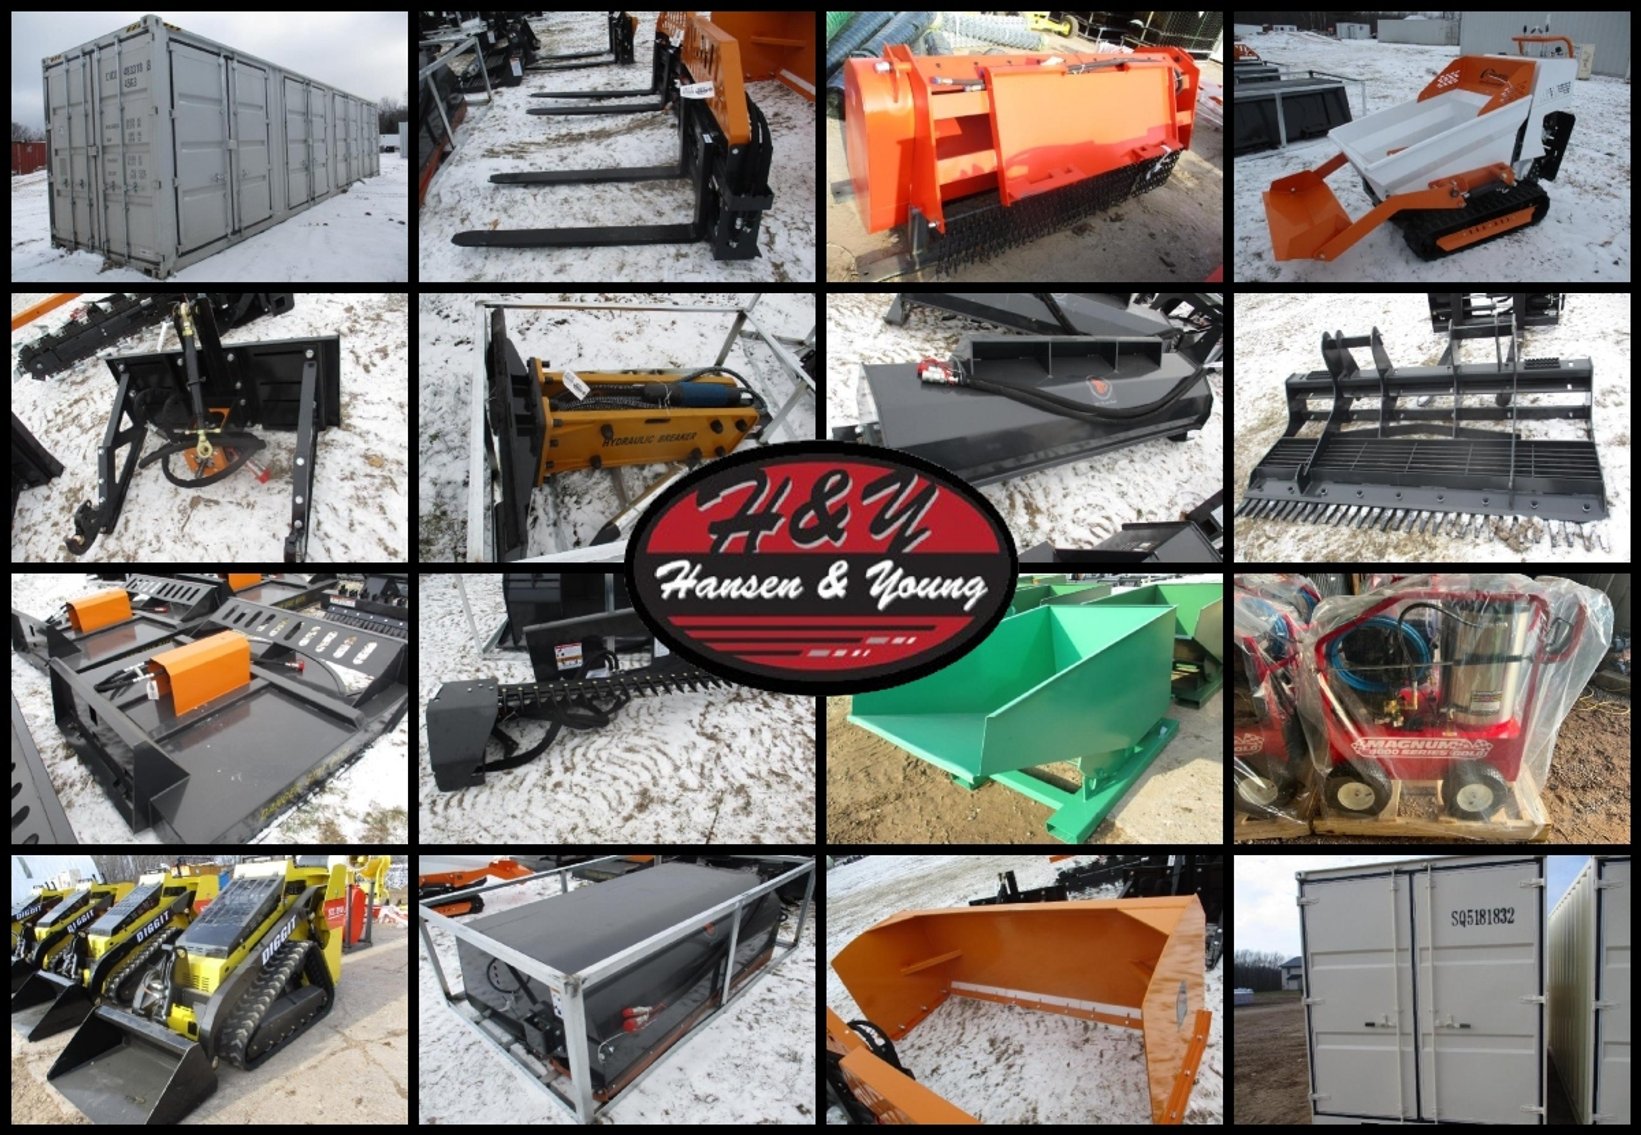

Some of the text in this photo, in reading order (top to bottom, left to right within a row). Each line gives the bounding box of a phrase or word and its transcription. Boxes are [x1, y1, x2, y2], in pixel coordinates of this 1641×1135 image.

[602, 431, 697, 447] HYDRAULIC BREAKER
[136, 910, 170, 943] DIGGIT
[1451, 907, 1516, 928] SQ5181832
[262, 914, 297, 966] DIGGIT
